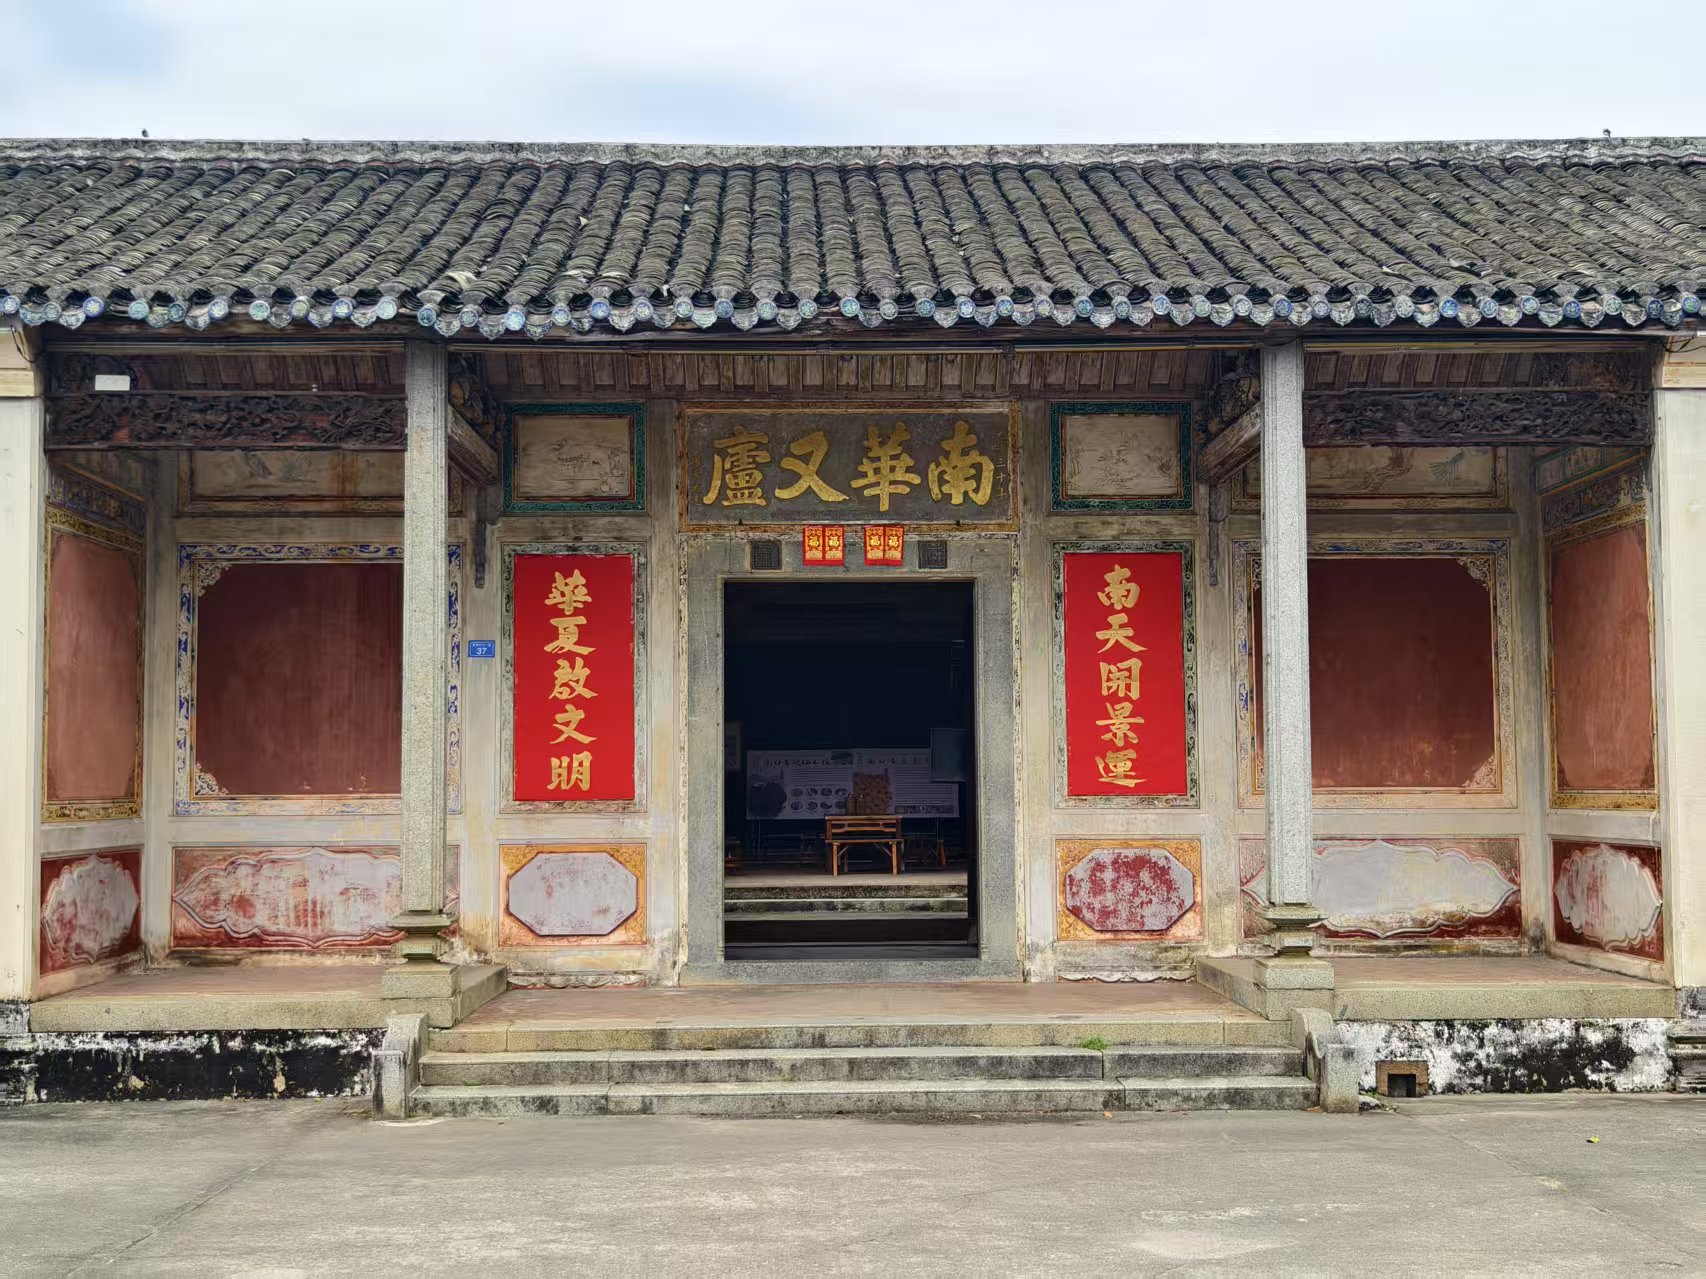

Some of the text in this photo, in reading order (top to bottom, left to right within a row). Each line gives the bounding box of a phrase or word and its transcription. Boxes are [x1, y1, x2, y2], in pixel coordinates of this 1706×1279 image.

[808, 535, 819, 547] 福
[828, 535, 840, 547] 福
[870, 535, 881, 546] 福
[888, 536, 899, 547] 福
[476, 647, 488, 655] 37
[1095, 564, 1148, 788] 南天開景運
